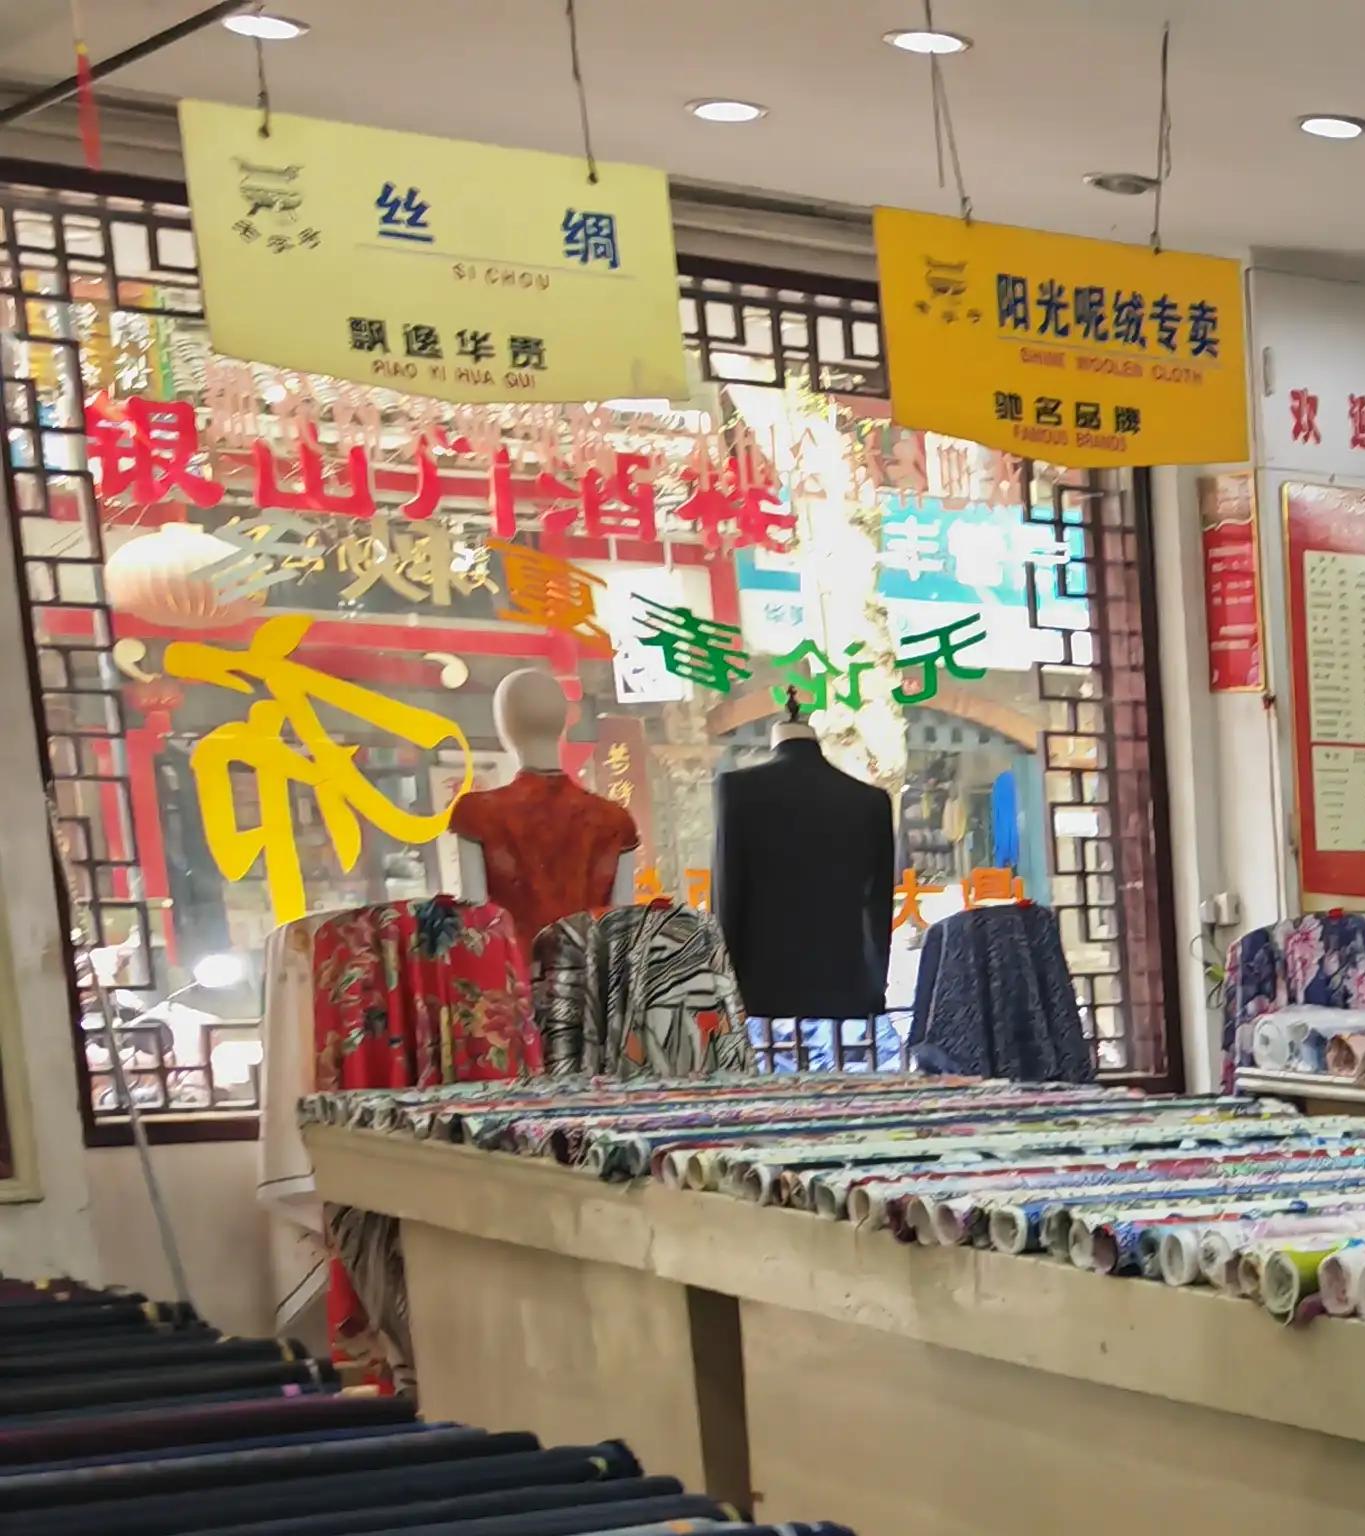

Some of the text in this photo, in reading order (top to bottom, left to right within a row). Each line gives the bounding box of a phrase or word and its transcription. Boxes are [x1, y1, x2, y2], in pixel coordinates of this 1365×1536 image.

[376, 180, 620, 271] 丝绸
[453, 262, 550, 291] SI CHOU
[996, 273, 1220, 358] 阳光呢绒专卖
[348, 317, 548, 371] 飘逸华贵
[372, 359, 418, 379] PIAO
[454, 366, 496, 385] HUA
[1151, 364, 1203, 385] CLOTH
[994, 391, 1142, 436] 驰名品牌
